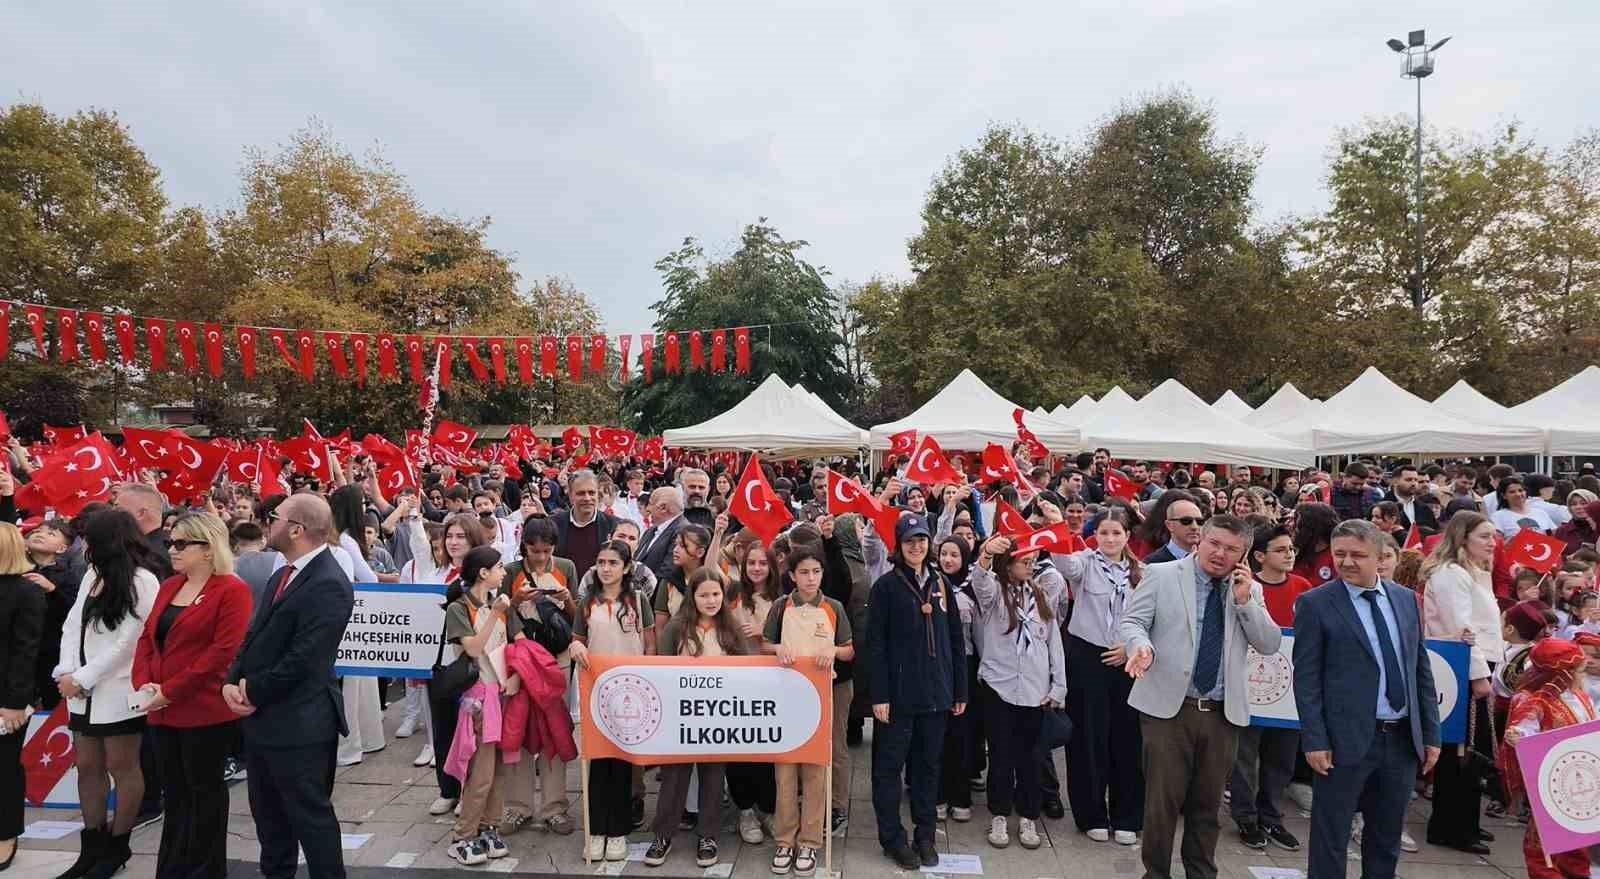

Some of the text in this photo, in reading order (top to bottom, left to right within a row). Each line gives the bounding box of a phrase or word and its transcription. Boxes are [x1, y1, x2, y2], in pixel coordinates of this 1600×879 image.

[349, 611, 411, 625] EL DÜZCE
[343, 630, 412, 646] AHÇEŞEHİR
[336, 648, 410, 662] ORTAOKULU
[679, 673, 724, 689] DÜZCE
[679, 696, 777, 717] BEYCİLER
[679, 723, 783, 745] İLKOKULU
